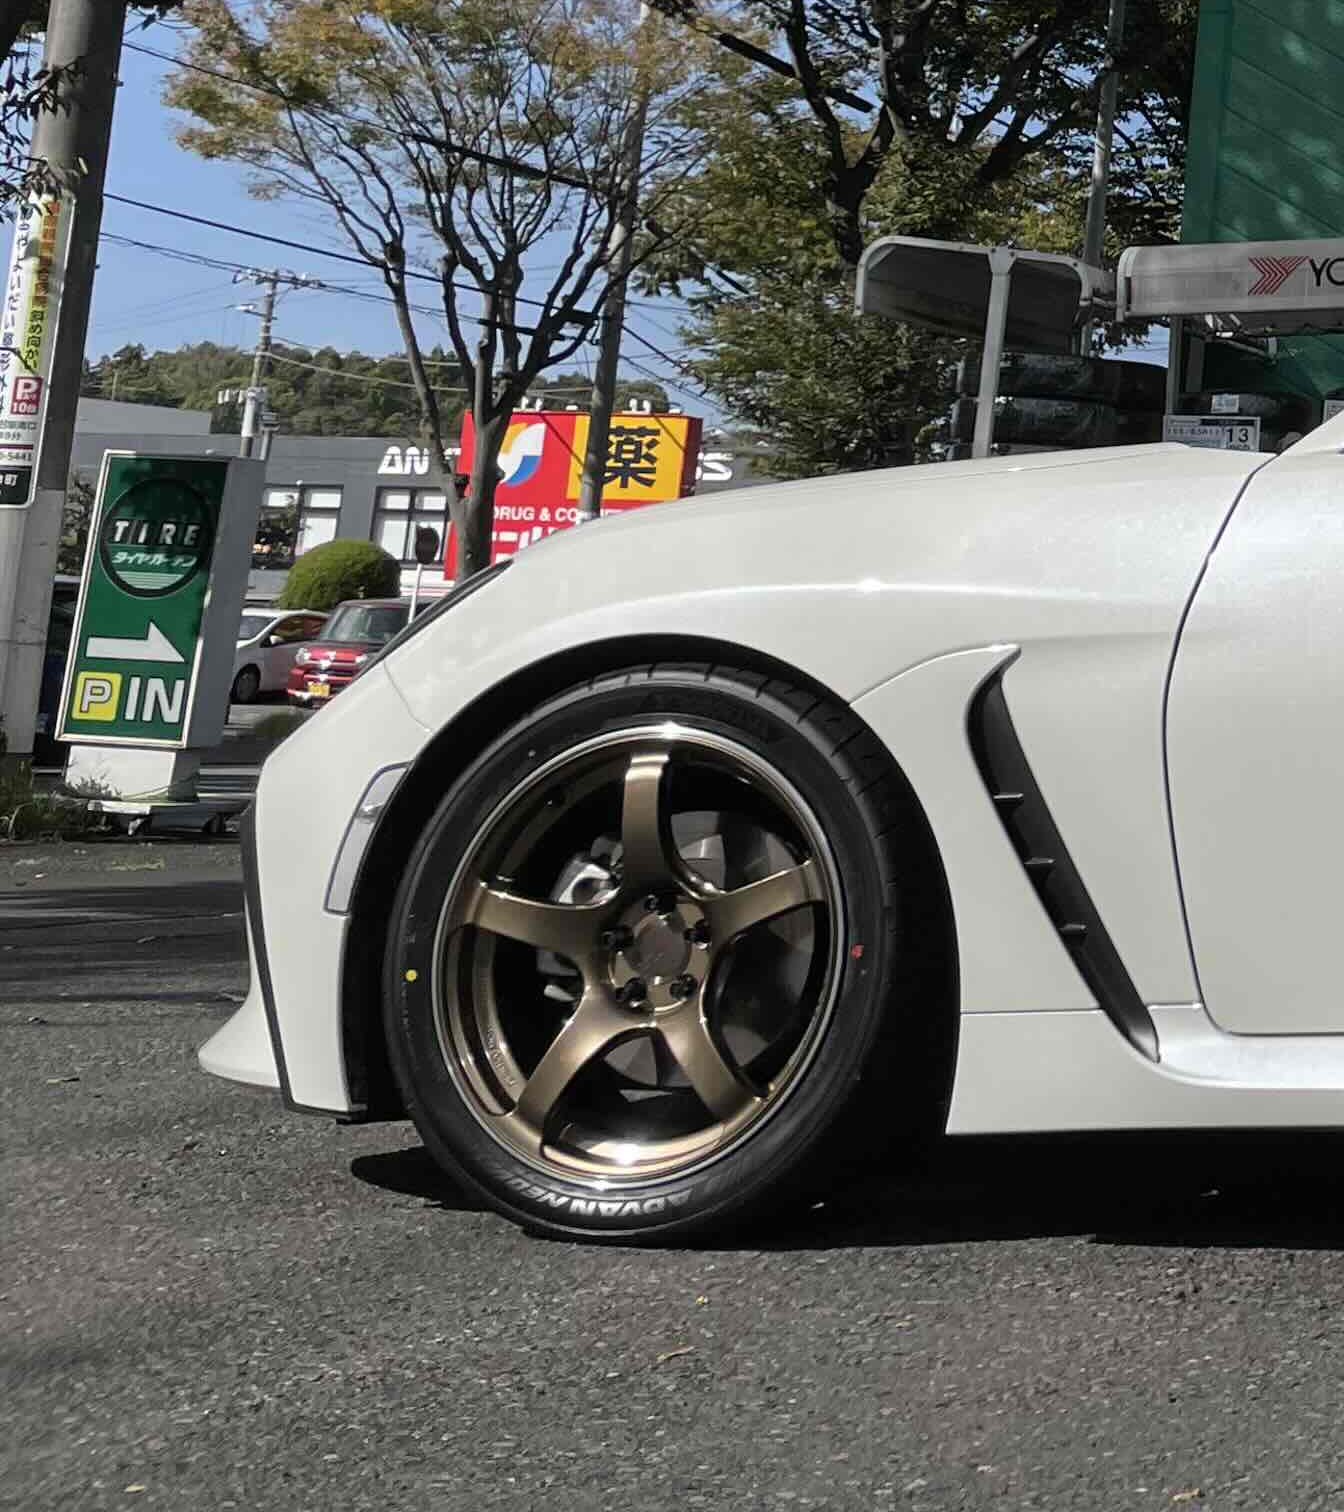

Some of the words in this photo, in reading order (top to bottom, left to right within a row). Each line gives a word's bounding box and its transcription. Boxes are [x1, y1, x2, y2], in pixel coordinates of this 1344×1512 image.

[1225, 427, 1249, 443] 13
[602, 425, 661, 489] 薬
[112, 519, 200, 546] TIRE
[79, 677, 113, 714] P
[123, 676, 185, 724] IN
[568, 1188, 693, 1218] ADVAN
